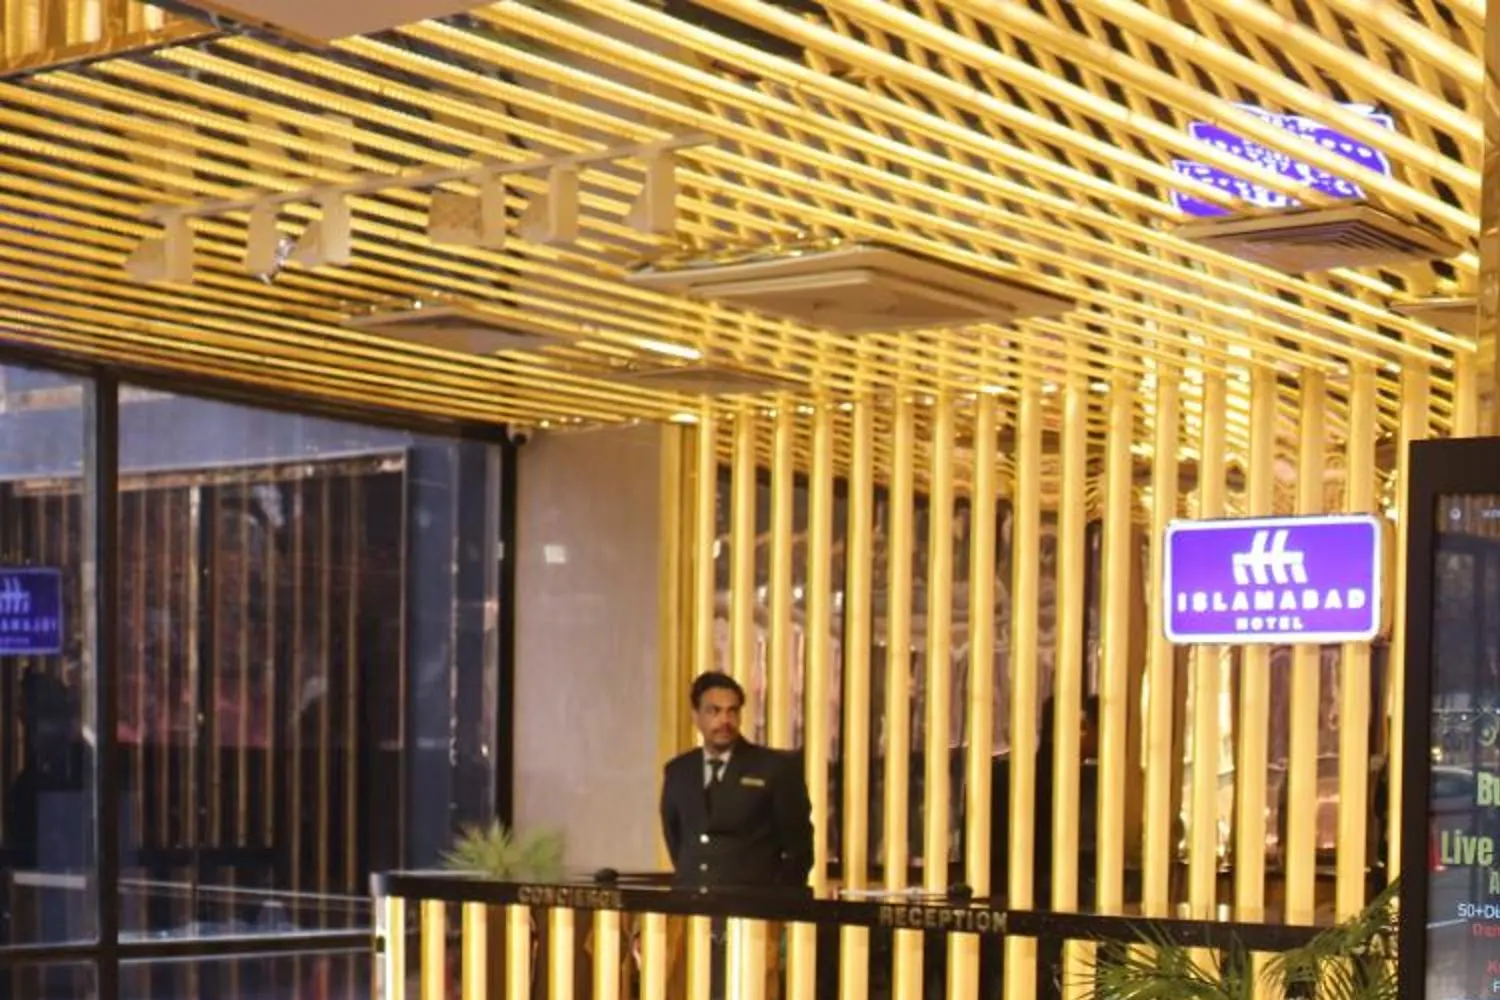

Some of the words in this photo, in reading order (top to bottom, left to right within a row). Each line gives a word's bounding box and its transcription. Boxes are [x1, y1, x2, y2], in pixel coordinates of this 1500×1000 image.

[1177, 588, 1366, 613] ISLAMABAD
[1235, 615, 1304, 631] HOTEL
[1440, 830, 1494, 866] Live
[879, 904, 1009, 934] RECEPTION
